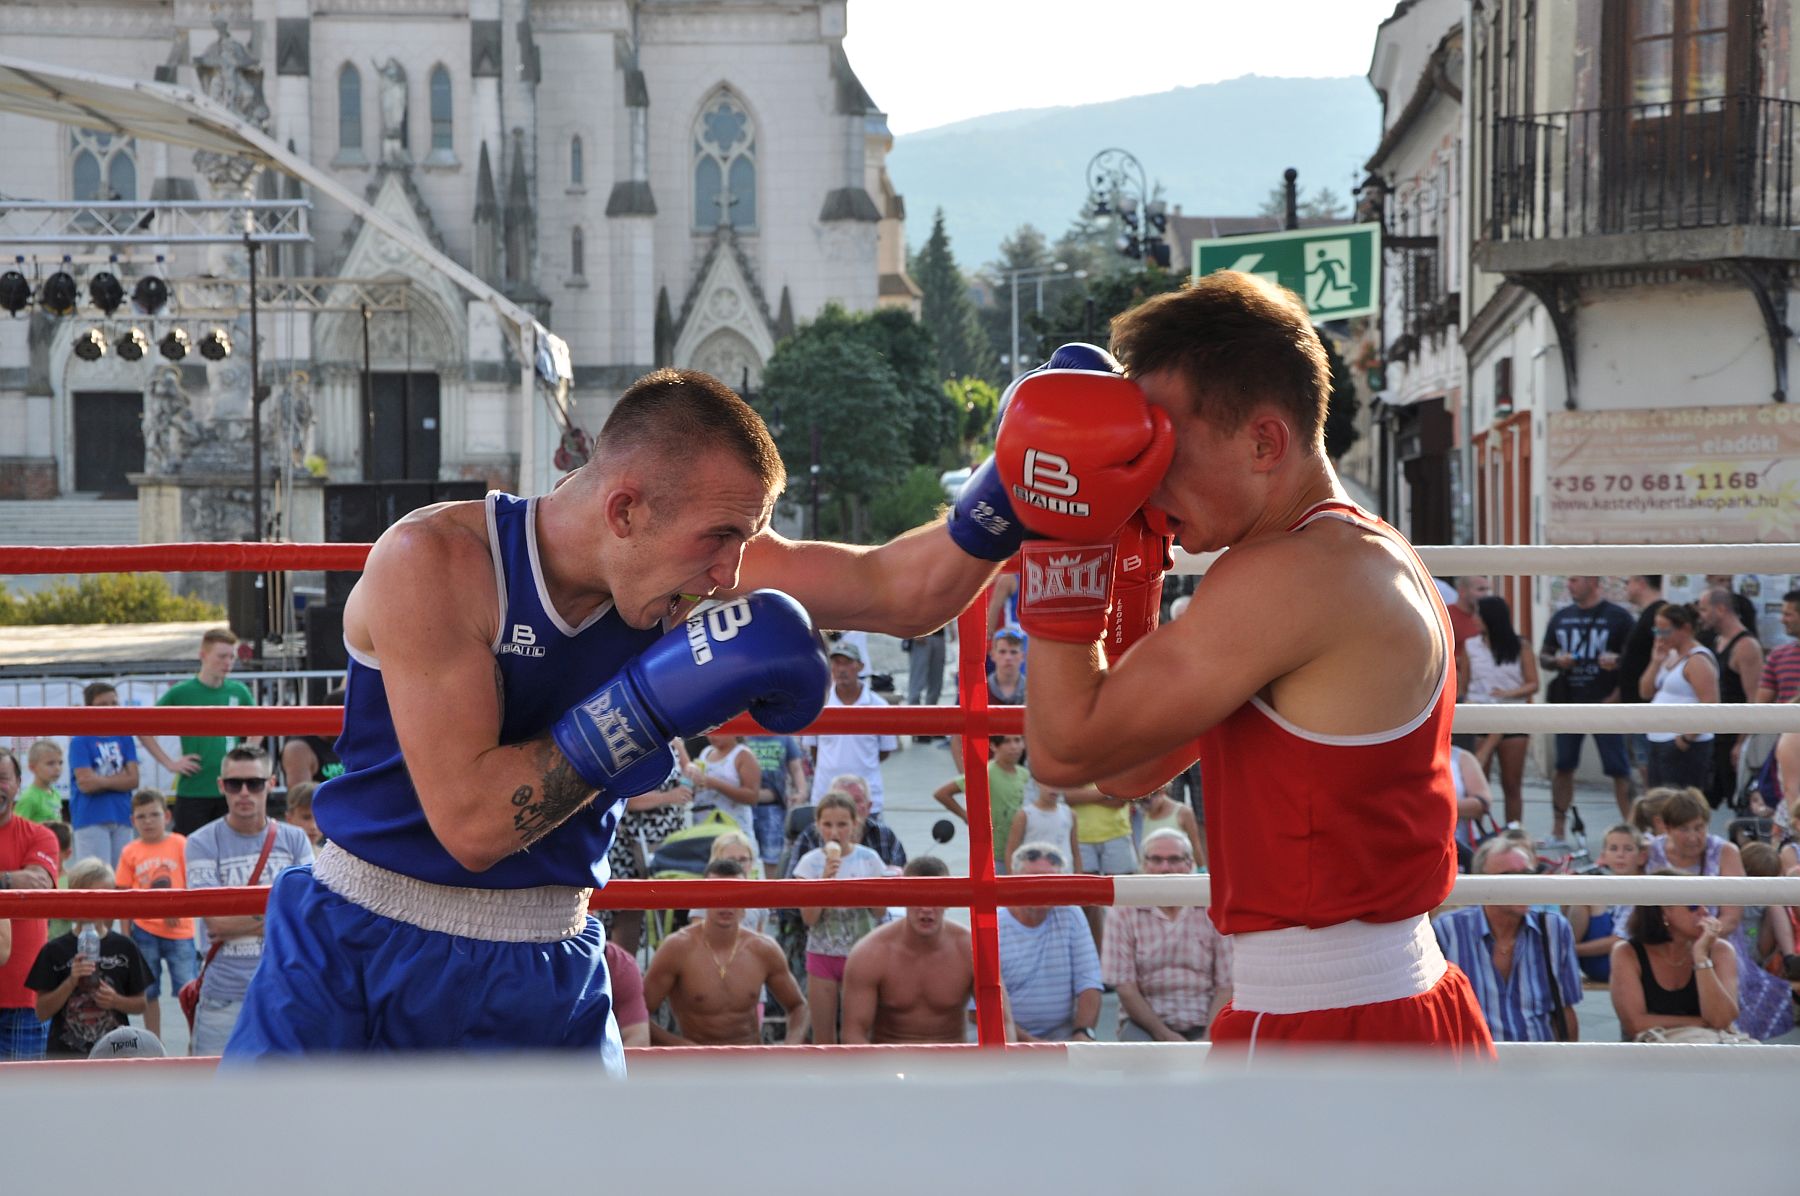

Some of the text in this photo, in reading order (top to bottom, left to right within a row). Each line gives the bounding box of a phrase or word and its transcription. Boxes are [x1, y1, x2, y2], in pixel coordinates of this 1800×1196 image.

[1552, 472, 1759, 492] +36 70 681 1168
[500, 643, 546, 657] BAIL
